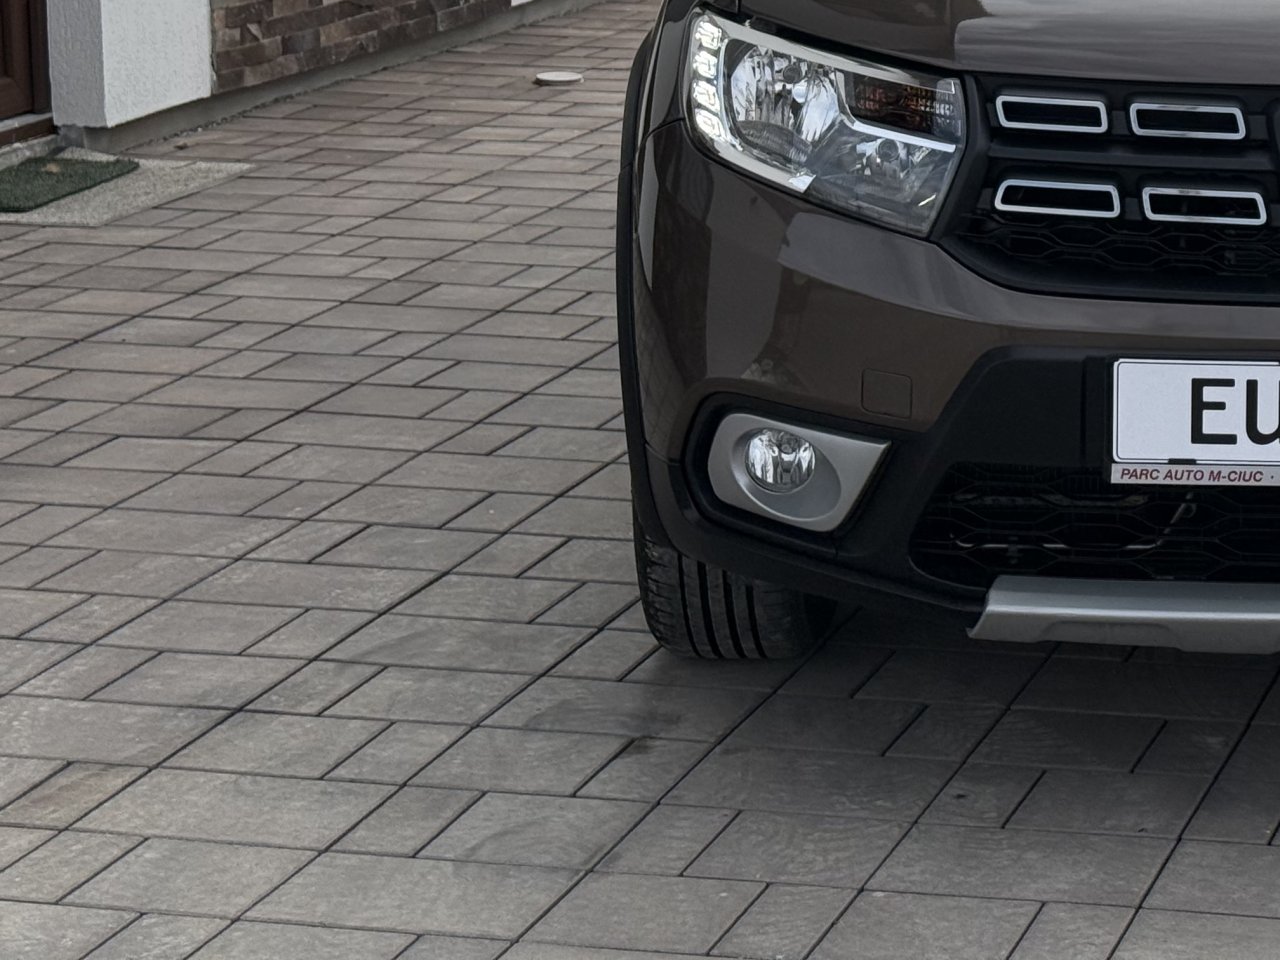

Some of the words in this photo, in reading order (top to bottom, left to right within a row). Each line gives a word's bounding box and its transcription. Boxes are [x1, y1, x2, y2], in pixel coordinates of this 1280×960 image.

[1120, 468, 1160, 481] PARC
[1163, 468, 1205, 481] AUTO
[1208, 470, 1264, 482] M-CIUC
